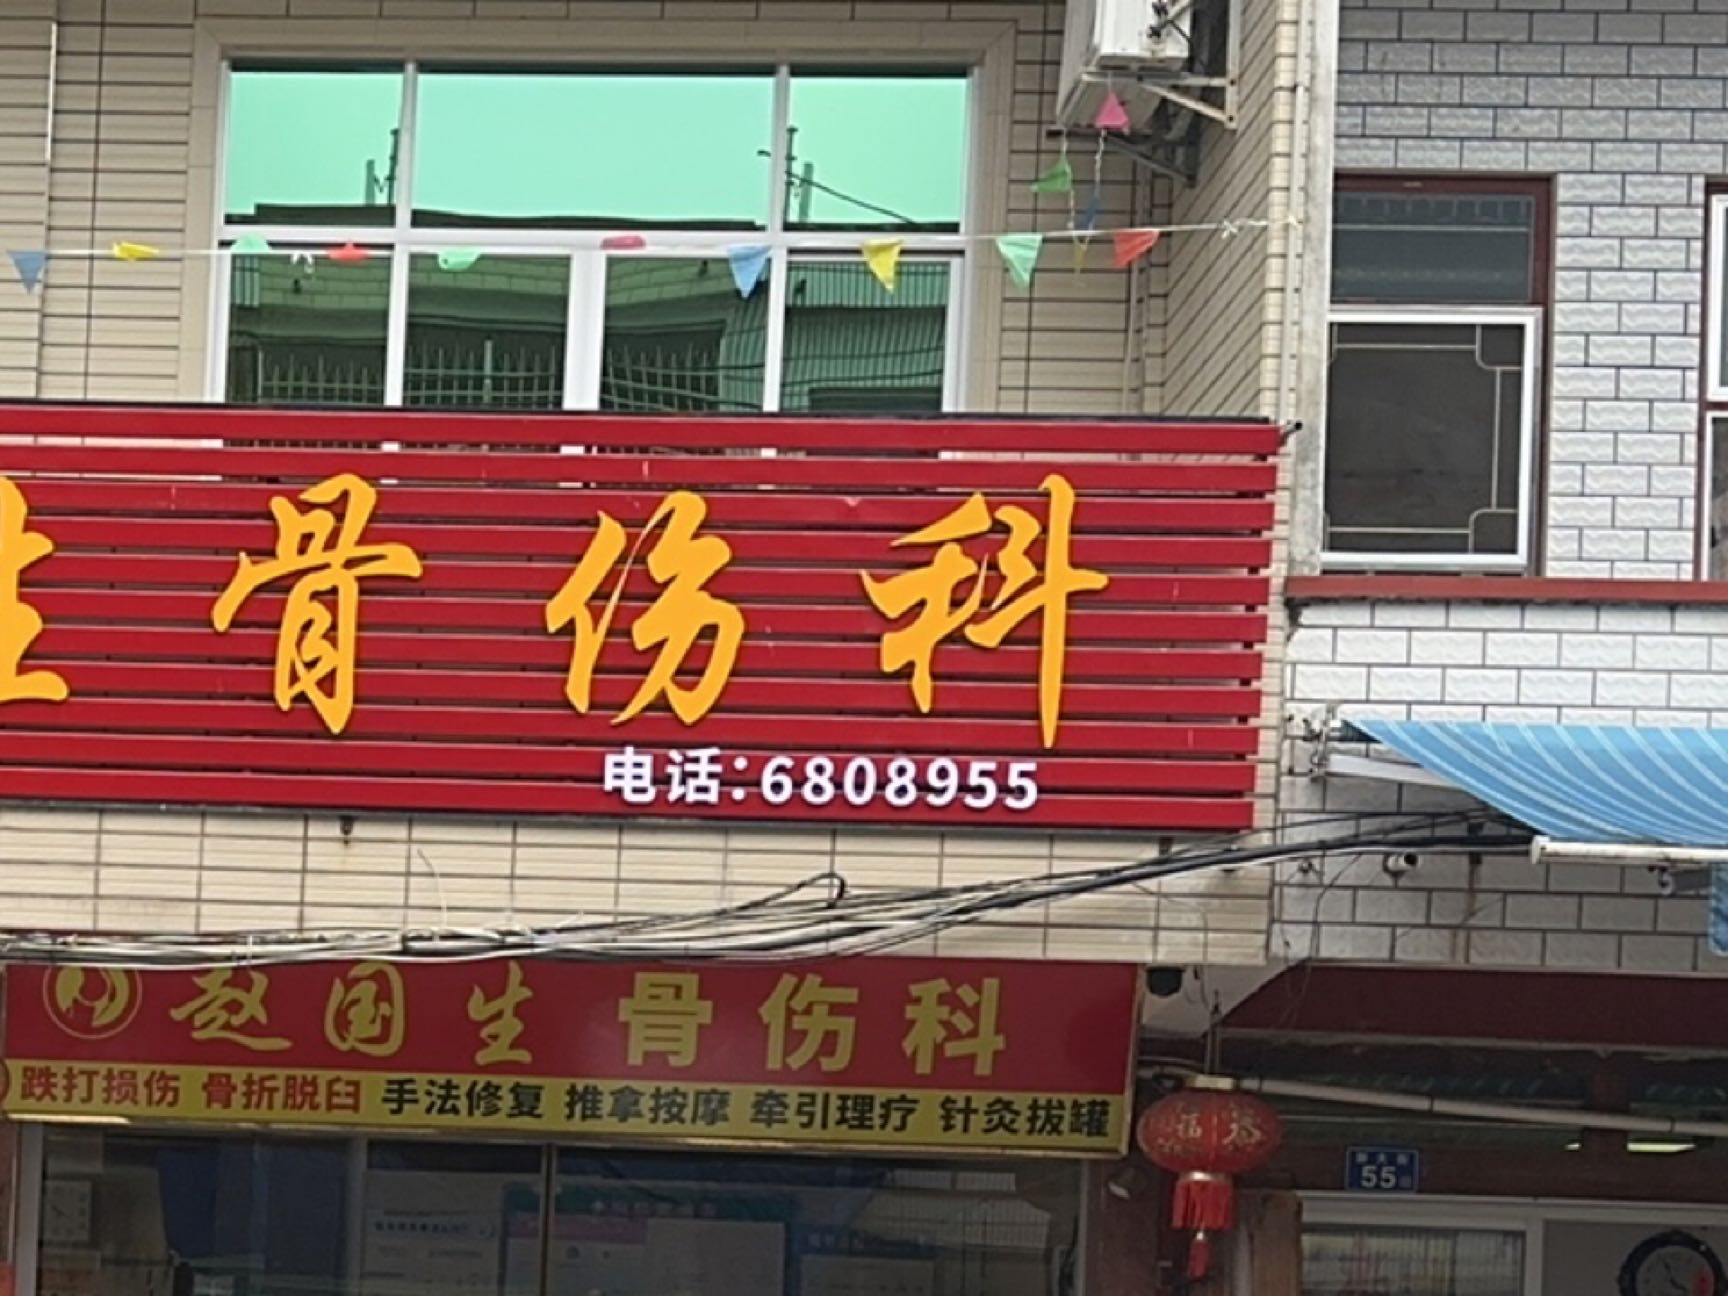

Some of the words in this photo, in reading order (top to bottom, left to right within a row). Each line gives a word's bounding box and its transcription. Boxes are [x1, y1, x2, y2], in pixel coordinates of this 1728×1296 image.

[21, 1064, 181, 1108] 跌打损伤
[201, 1072, 362, 1115] 骨折脱臼
[381, 1077, 545, 1119] 手法修复
[564, 1084, 732, 1125] 推拿按摩
[749, 1089, 922, 1135] 牵引理疗
[939, 1095, 1112, 1138] 针灸拔罐
